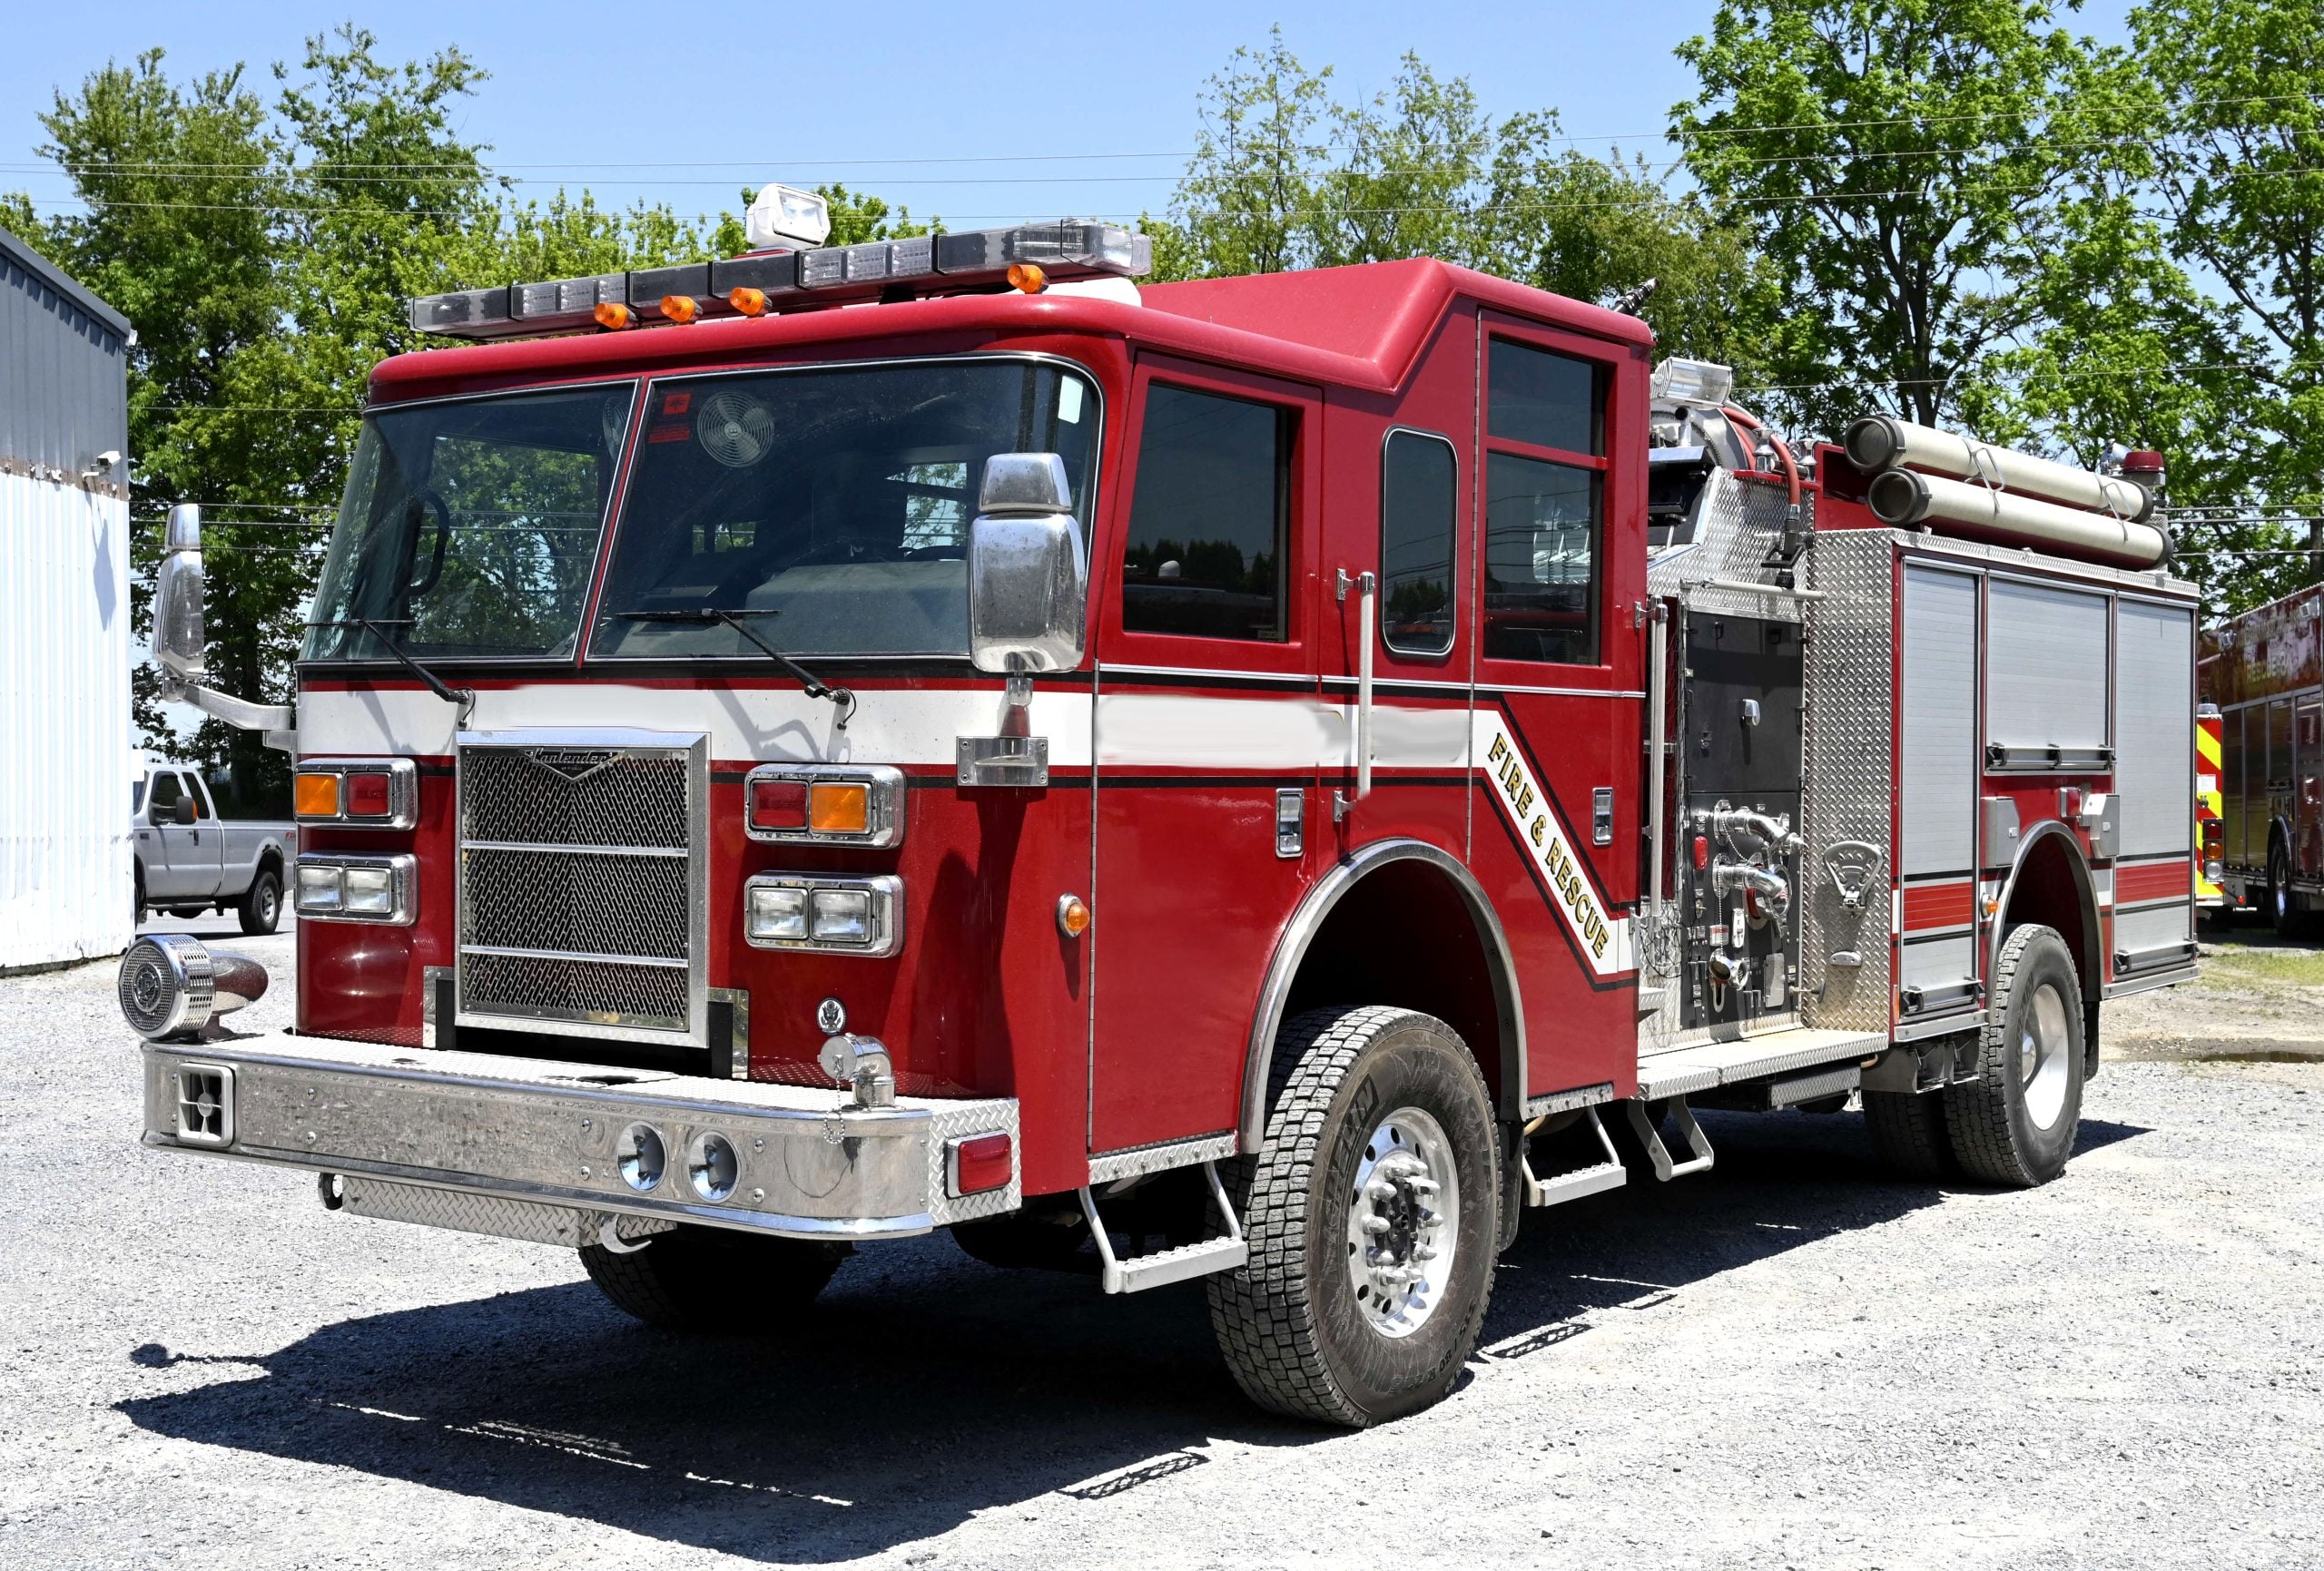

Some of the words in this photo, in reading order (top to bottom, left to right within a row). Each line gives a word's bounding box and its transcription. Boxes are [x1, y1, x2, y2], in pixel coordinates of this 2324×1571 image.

[1487, 731, 1534, 820] FIRE
[1531, 813, 1547, 848] &
[1544, 836, 1610, 959] RESCUE
